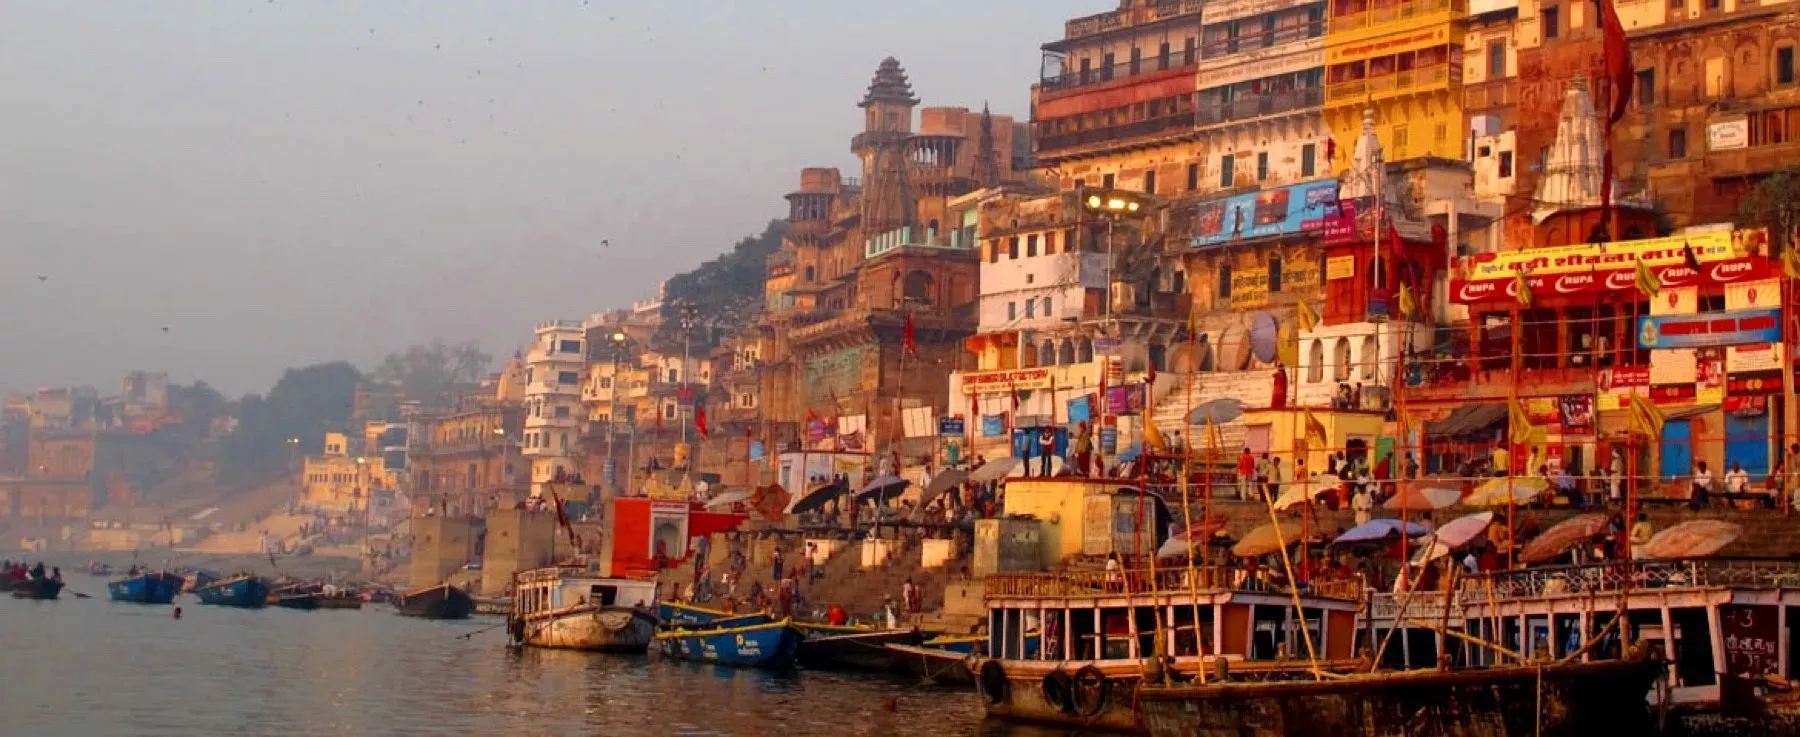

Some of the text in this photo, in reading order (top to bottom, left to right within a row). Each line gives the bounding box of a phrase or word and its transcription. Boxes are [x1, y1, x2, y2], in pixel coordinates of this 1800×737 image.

[1468, 282, 1495, 293] RUPA
[1564, 275, 1593, 285] RUPA
[1721, 262, 1752, 272] RUPA
